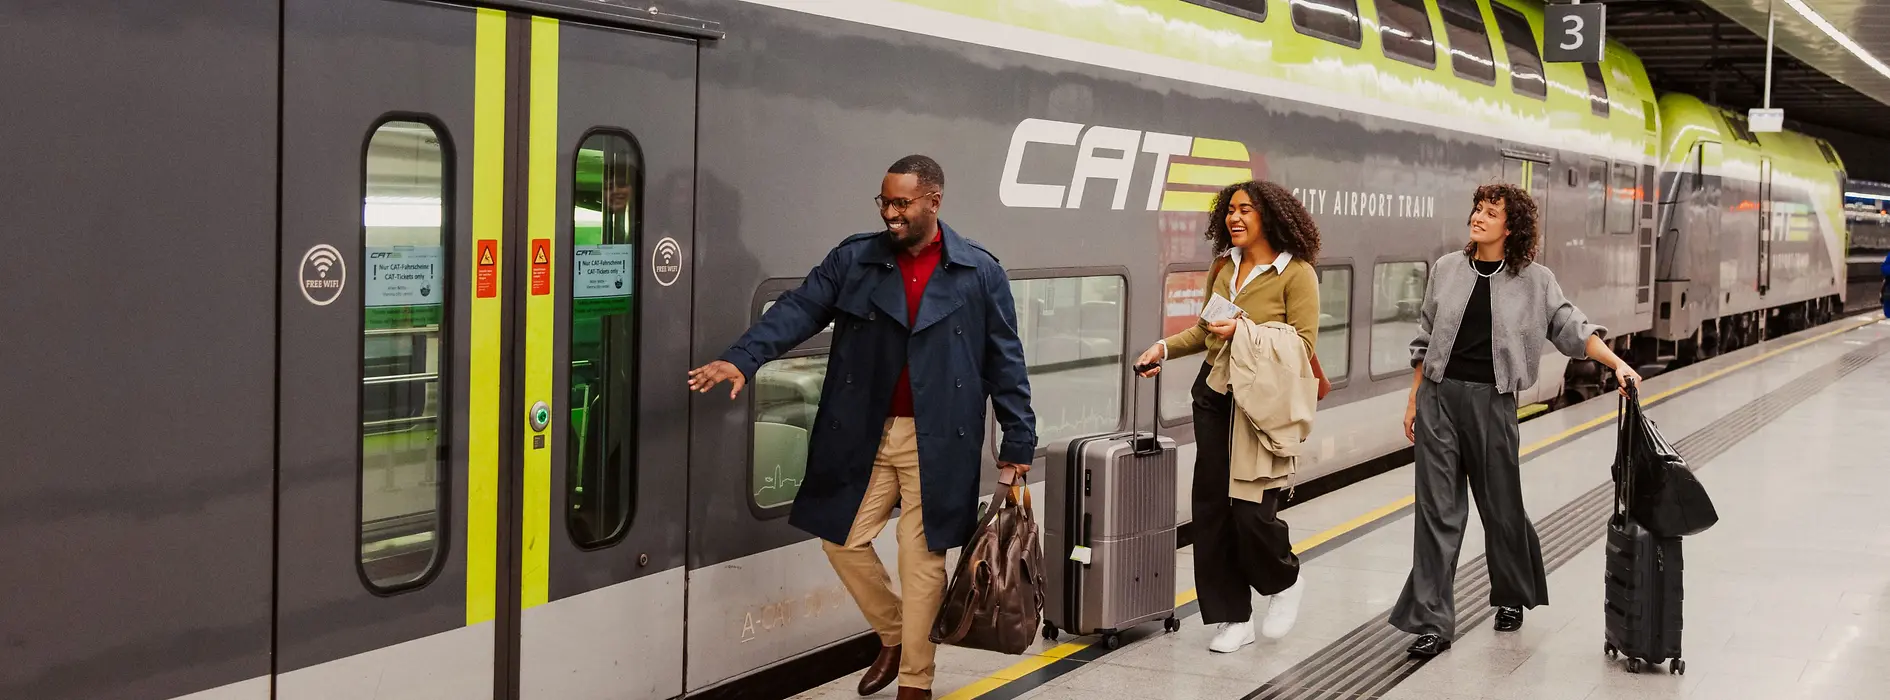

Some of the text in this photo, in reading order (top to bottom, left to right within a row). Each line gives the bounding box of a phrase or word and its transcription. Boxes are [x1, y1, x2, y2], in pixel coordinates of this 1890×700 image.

[1560, 15, 1584, 50] 3
[999, 118, 1193, 211] CAT
[1333, 190, 1392, 217] AIRPORT
[1398, 194, 1434, 218] TRAIN
[656, 265, 667, 273] FREE
[306, 280, 339, 288] FREE WIFI
